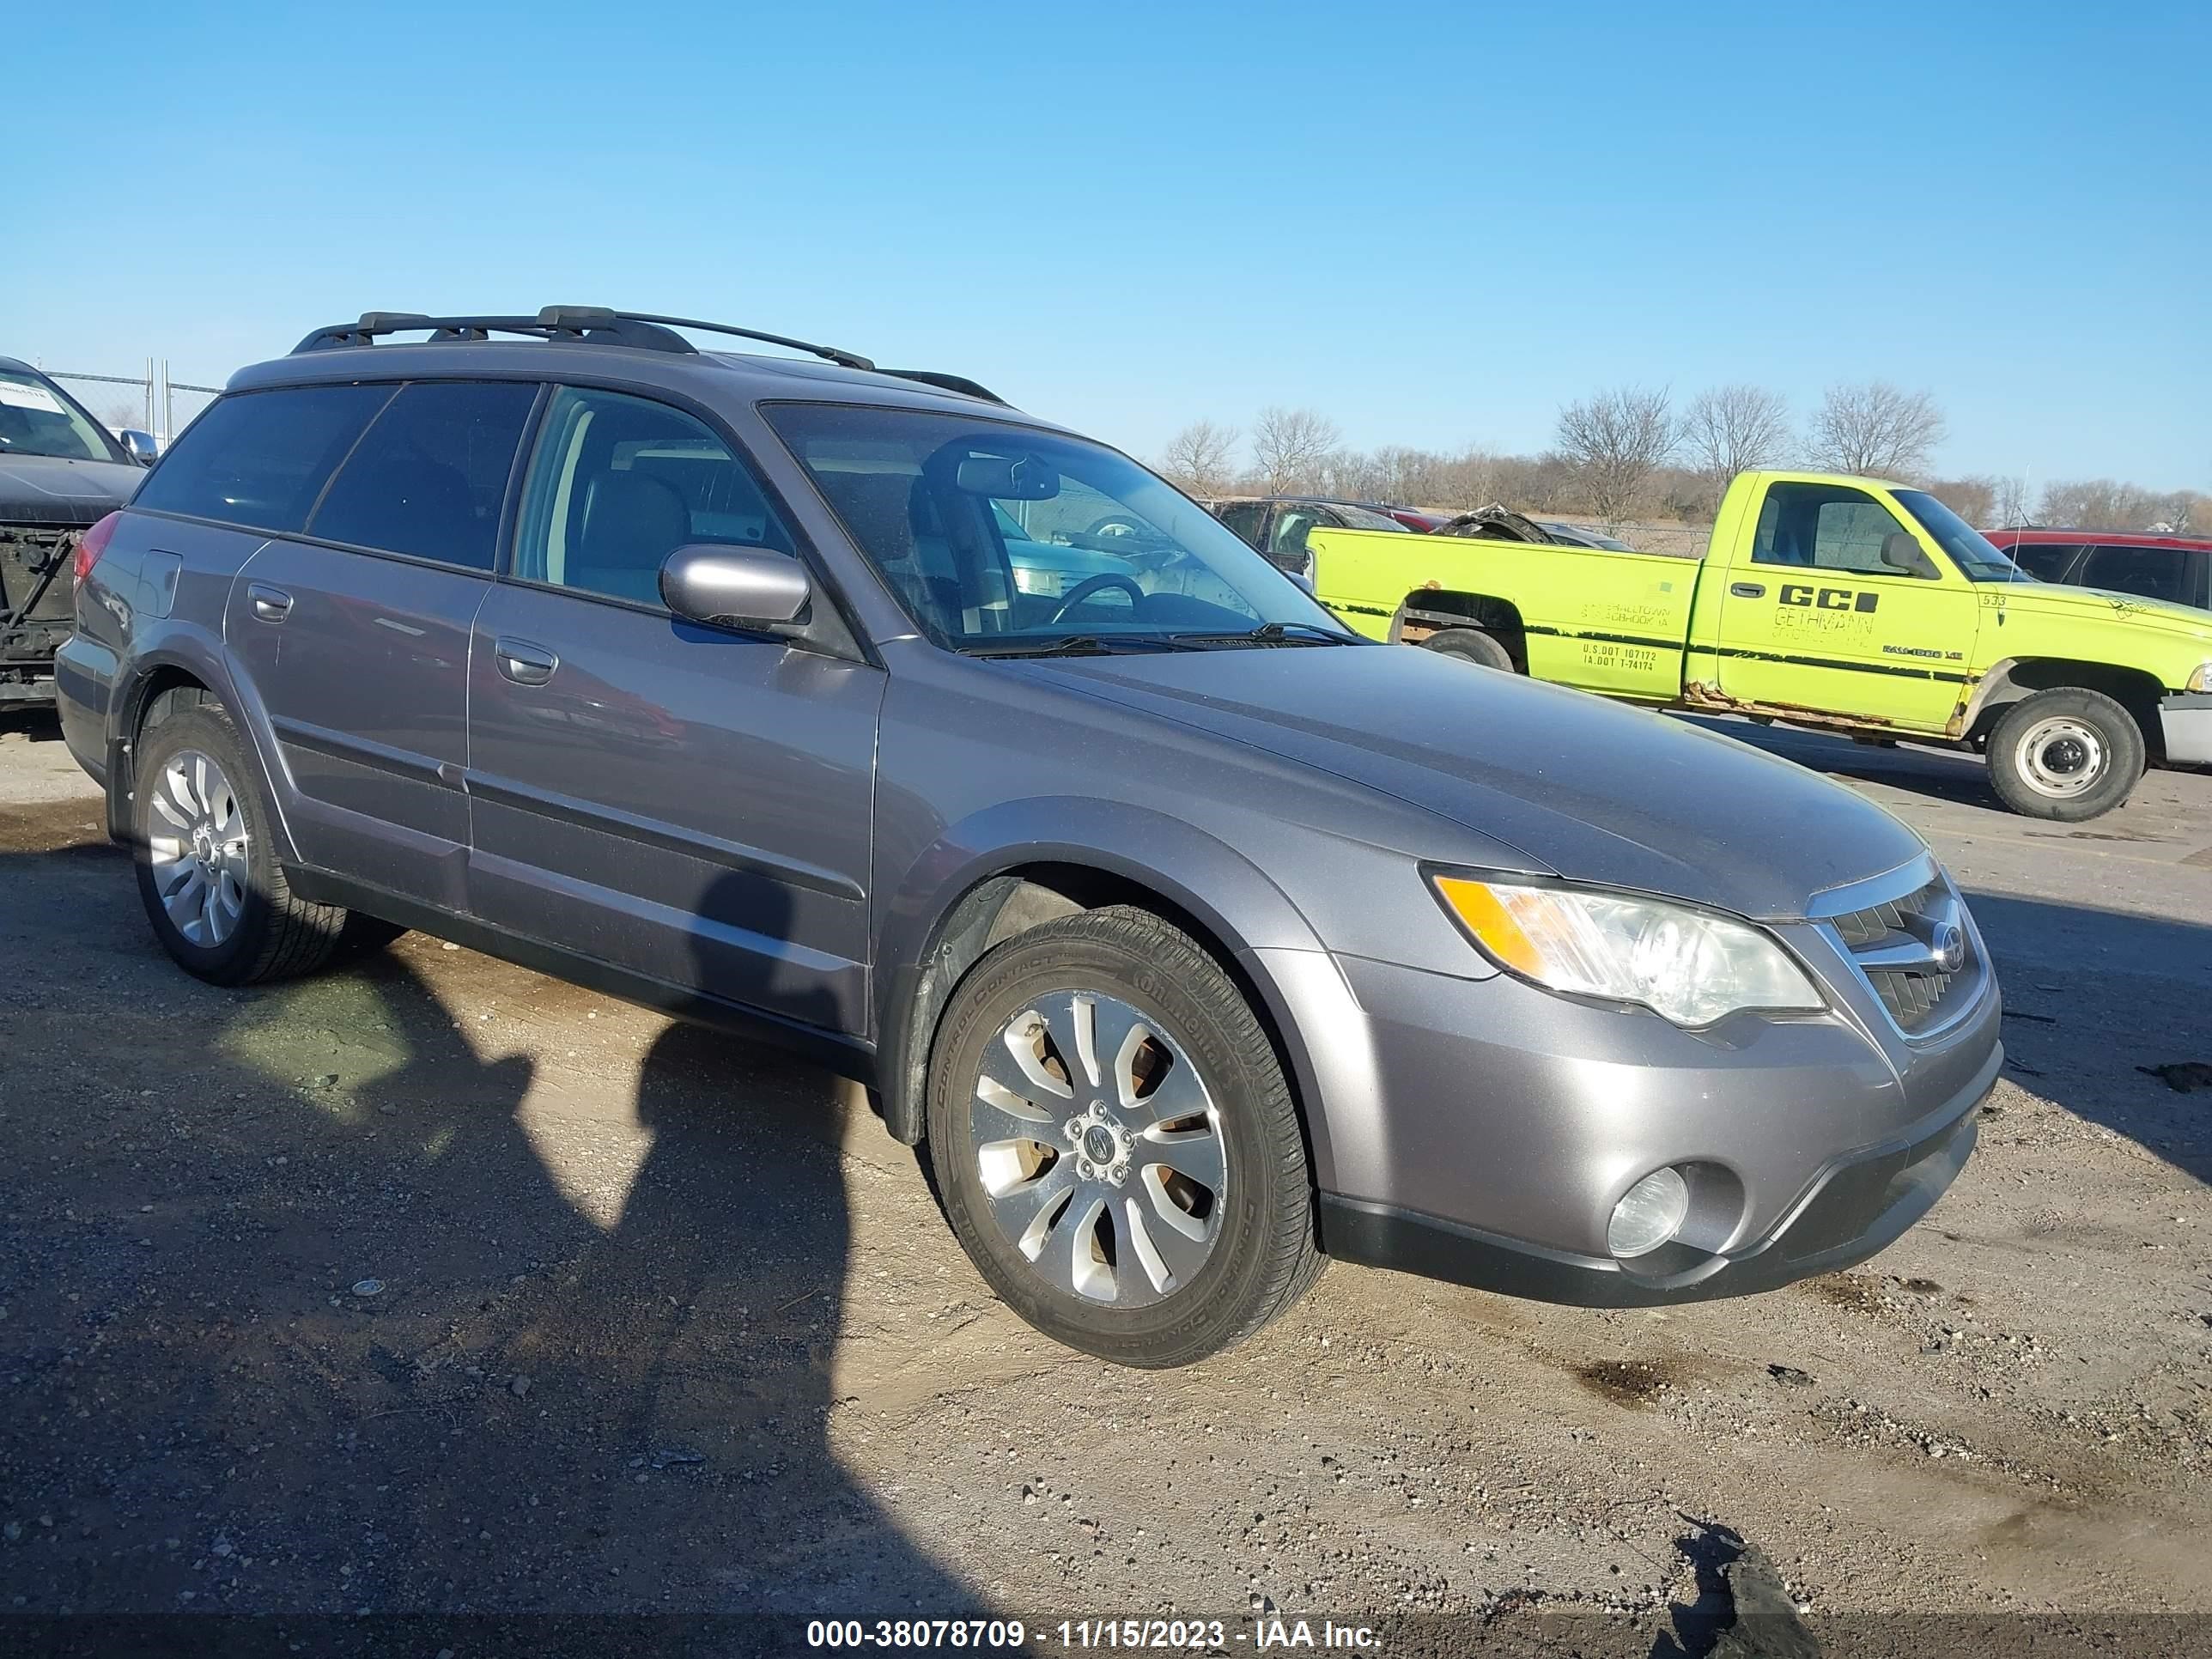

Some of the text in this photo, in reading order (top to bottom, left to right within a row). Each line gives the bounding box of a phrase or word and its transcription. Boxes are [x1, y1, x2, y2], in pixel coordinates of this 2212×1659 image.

[1984, 595, 2006, 606] 533
[1775, 606, 1874, 635] GETHMANN
[1625, 648, 1656, 661] 107172
[937, 1009, 975, 1109] CONTROL
[973, 956, 1053, 1007] CONTACT
